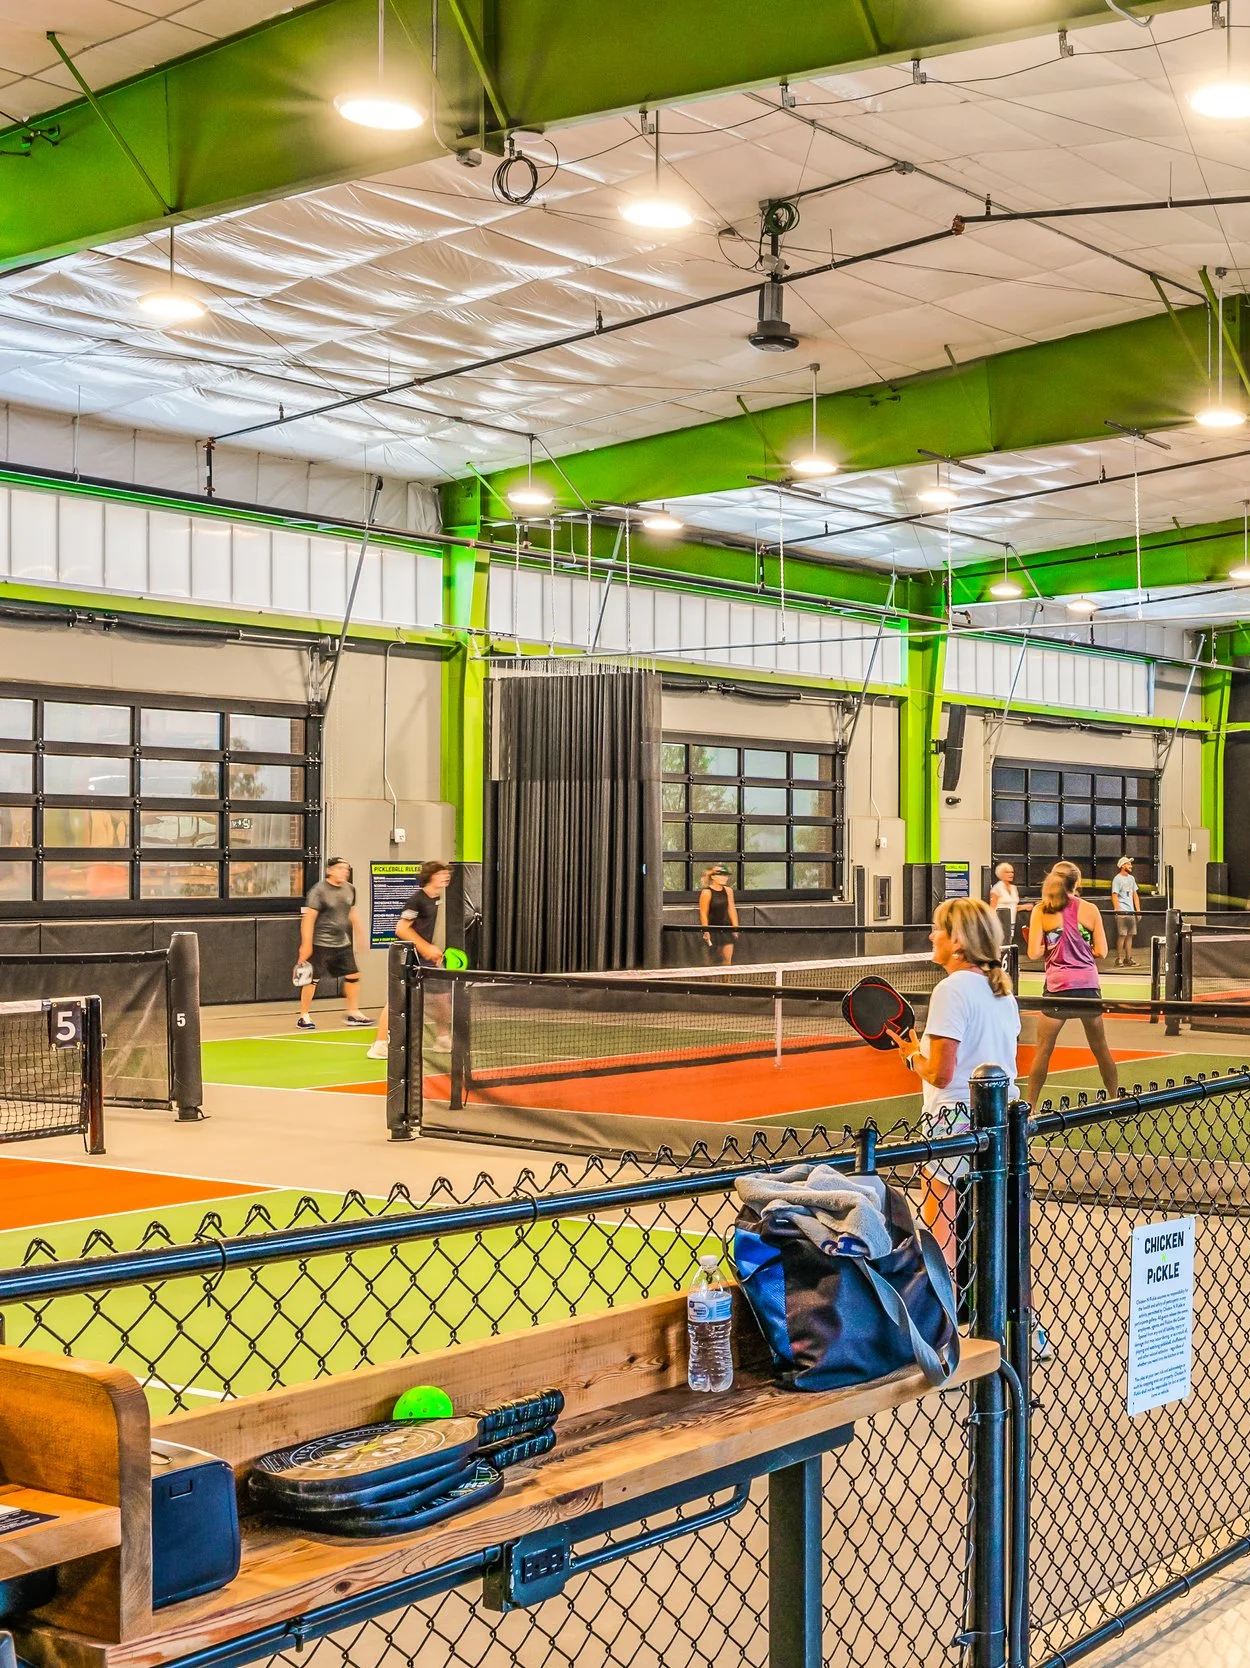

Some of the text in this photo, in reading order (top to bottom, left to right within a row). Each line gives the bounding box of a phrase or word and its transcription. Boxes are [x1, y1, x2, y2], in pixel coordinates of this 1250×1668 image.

[56, 1011, 76, 1041] 5
[176, 1013, 186, 1027] 5
[1144, 1231, 1184, 1254] CHICKEN
